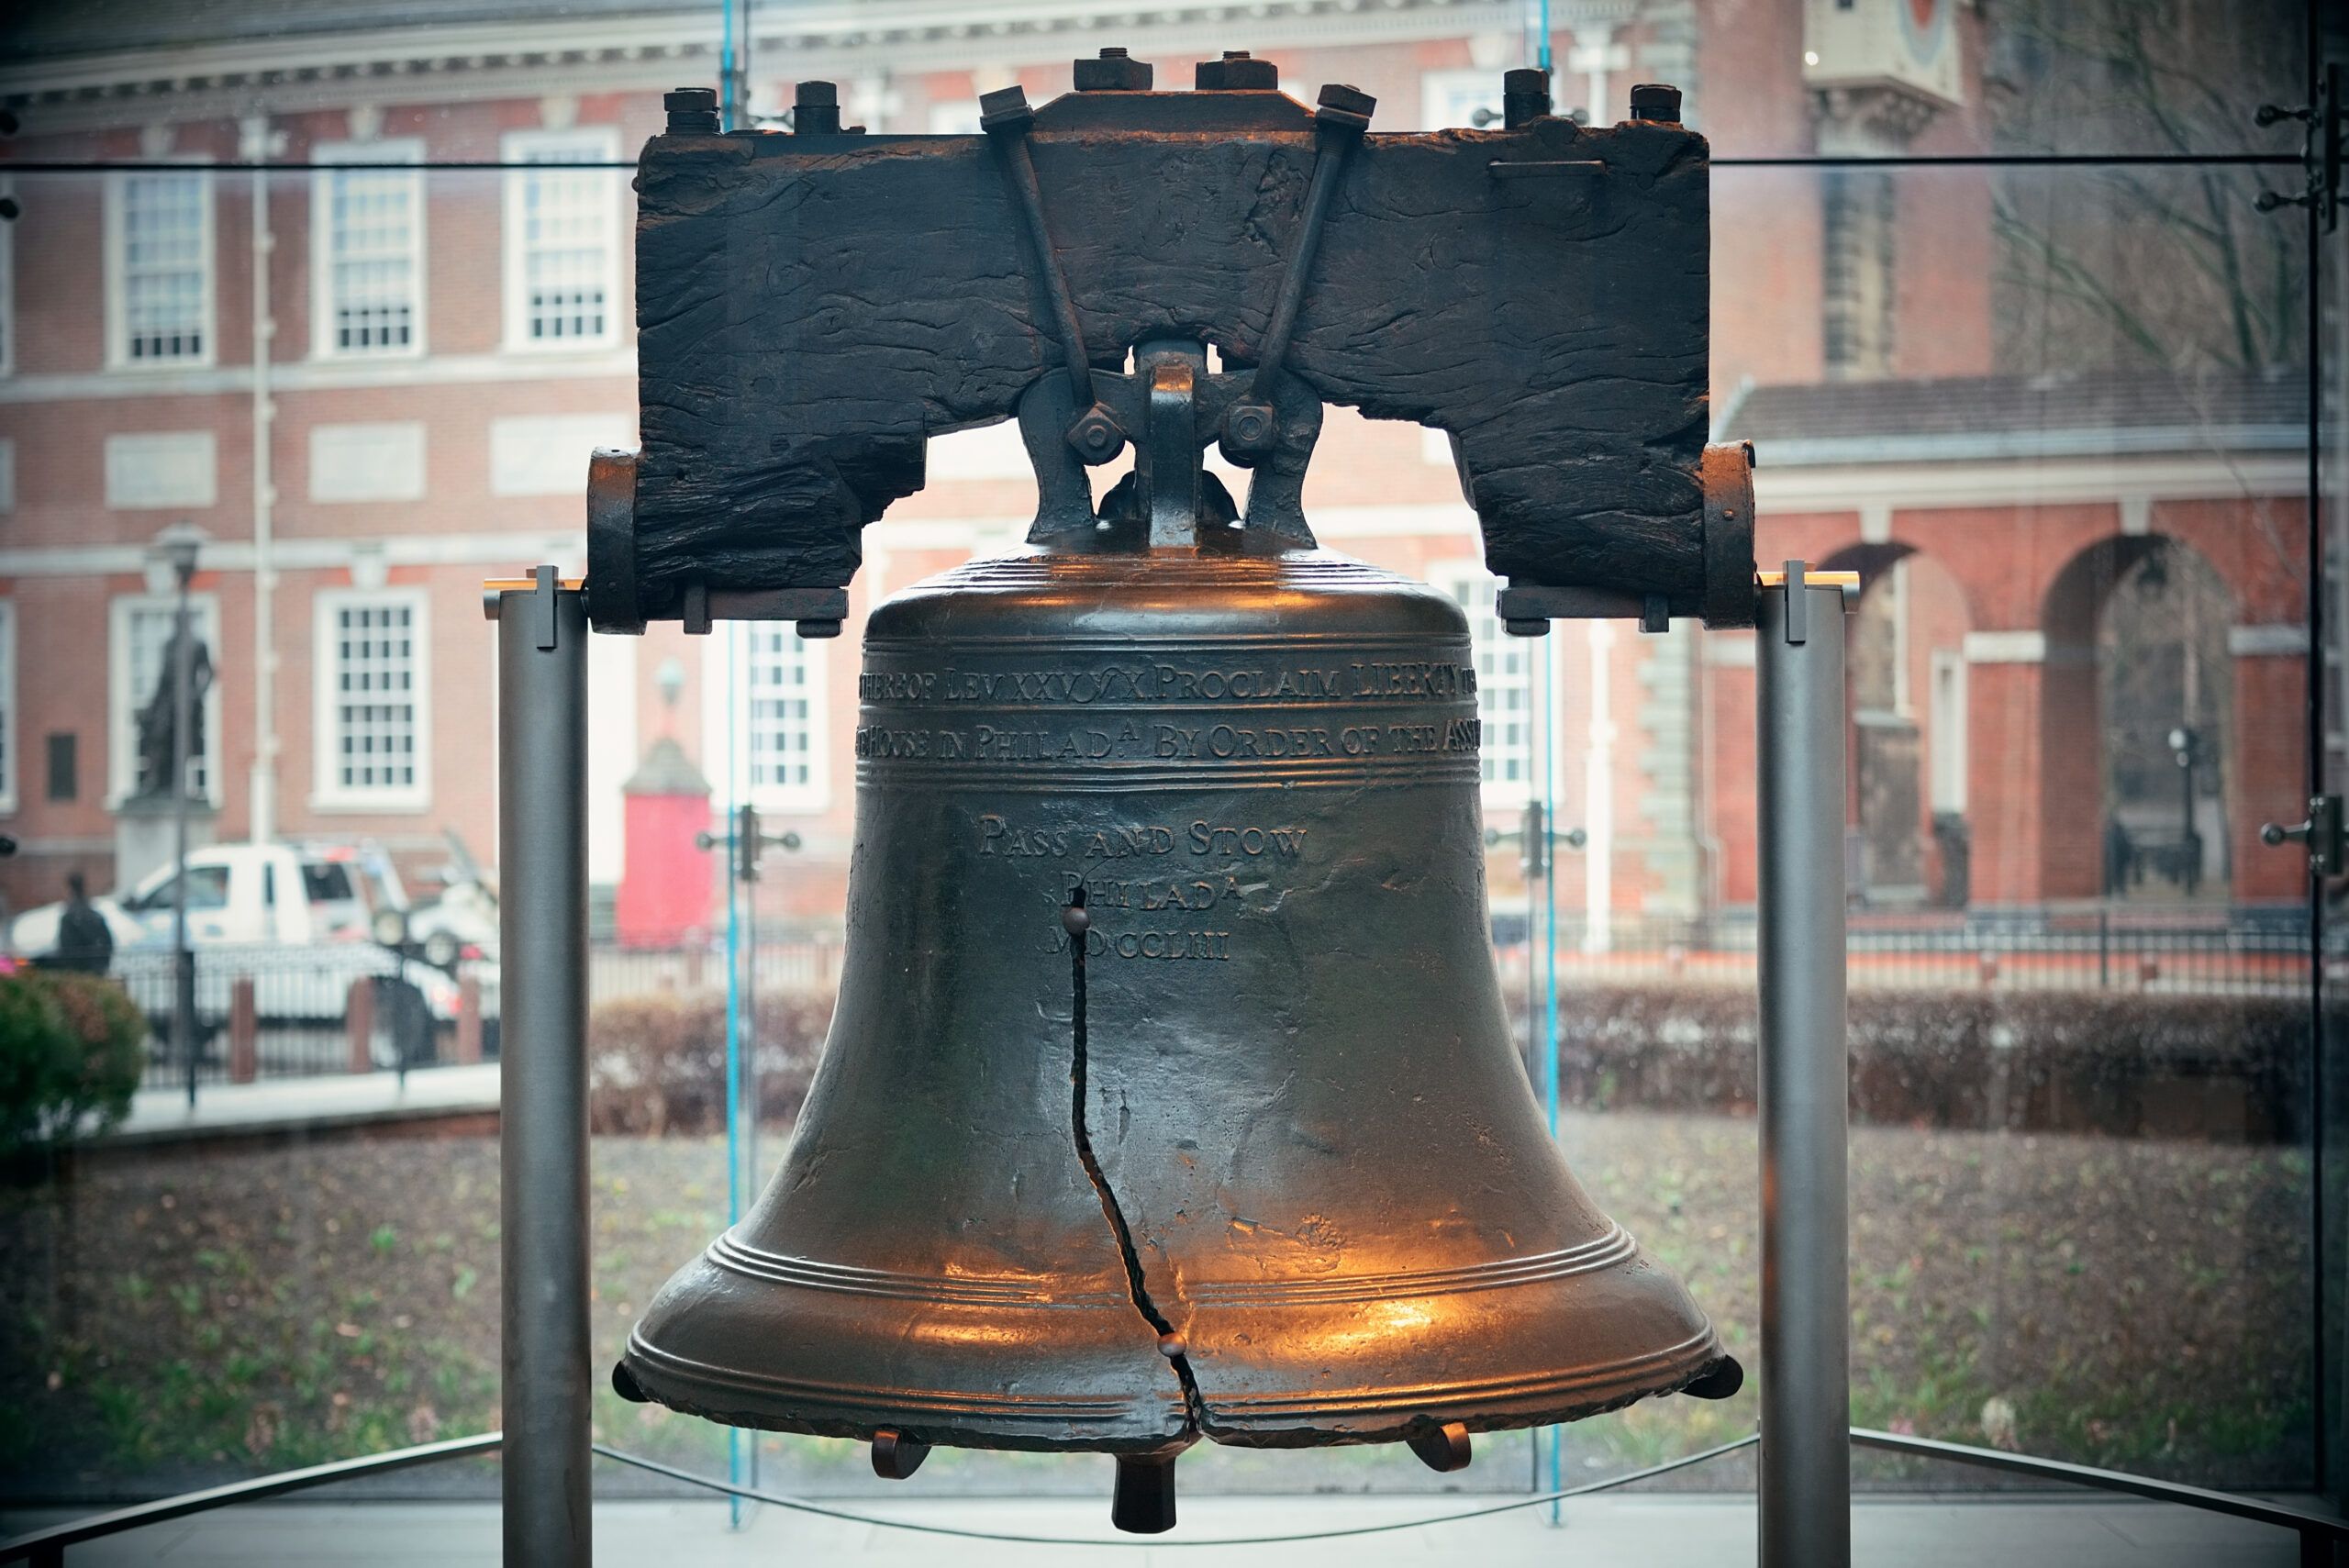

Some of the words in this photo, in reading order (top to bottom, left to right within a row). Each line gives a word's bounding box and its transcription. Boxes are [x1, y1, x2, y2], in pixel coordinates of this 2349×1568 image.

[1153, 664, 1341, 700] PROCLAIM
[1351, 662, 1460, 697] LIBERTY
[1153, 724, 1201, 758] BY
[1208, 724, 1333, 758] ORDER
[1341, 726, 1380, 756] OF
[1388, 725, 1438, 752] THE
[977, 815, 1070, 858] PASS
[1085, 826, 1175, 858] AND
[1189, 821, 1307, 857] STOW
